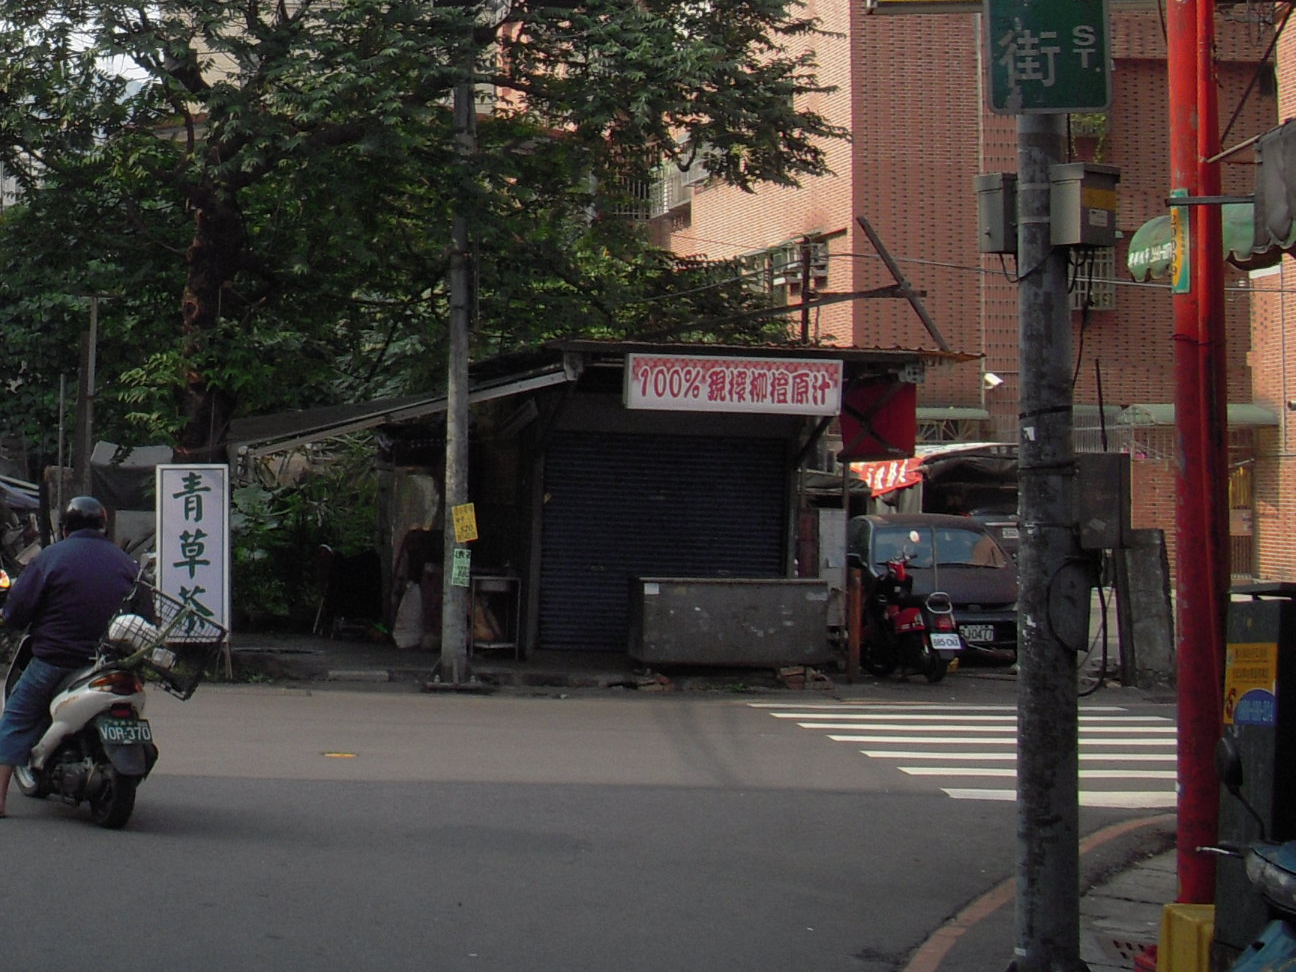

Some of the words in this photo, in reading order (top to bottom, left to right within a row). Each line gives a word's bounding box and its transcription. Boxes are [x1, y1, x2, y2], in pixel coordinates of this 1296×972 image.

[173, 472, 214, 636] 青草茶
[100, 725, 151, 741] VOR-370
